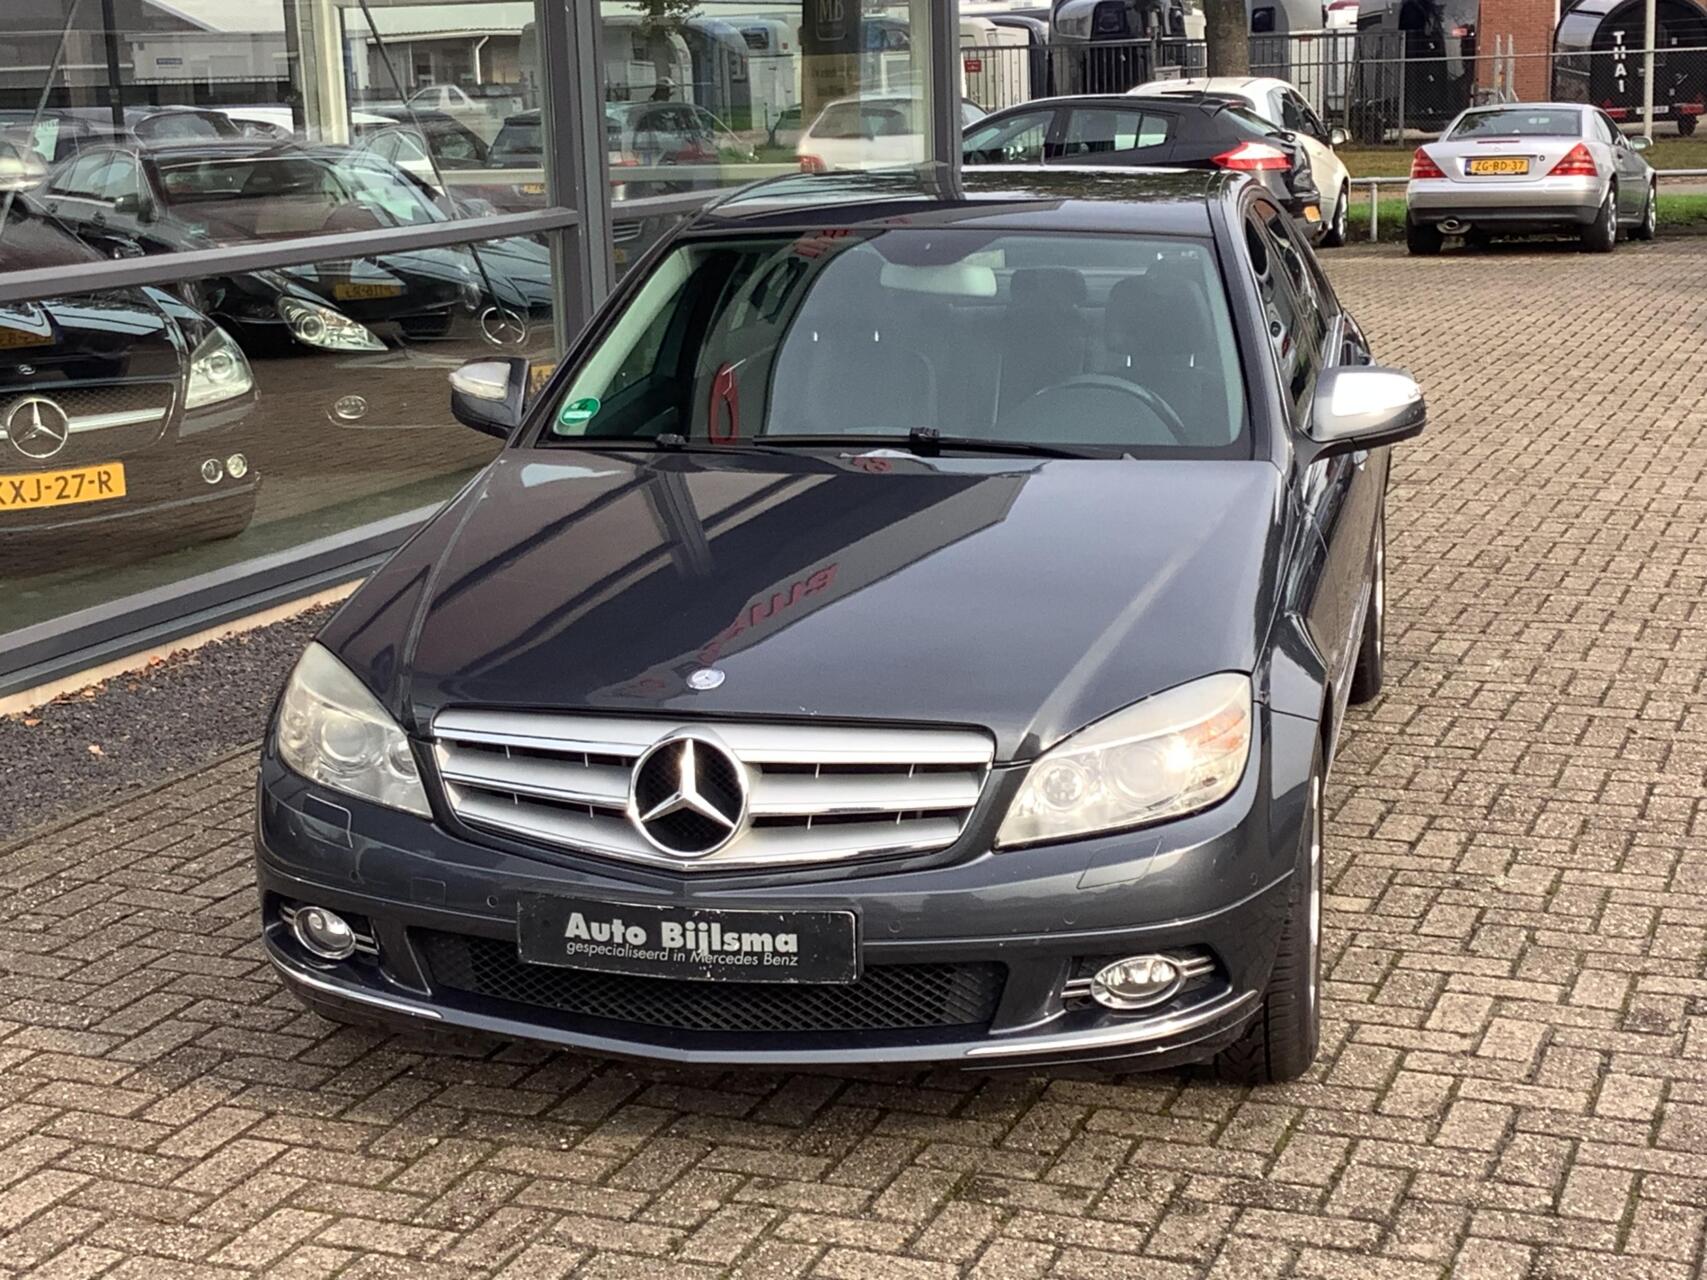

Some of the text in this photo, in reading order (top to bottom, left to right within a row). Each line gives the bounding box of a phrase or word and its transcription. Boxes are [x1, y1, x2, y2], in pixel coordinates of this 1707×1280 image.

[1613, 31, 1627, 93] THAI
[1475, 160, 1525, 172] ZG-BD-37
[564, 911, 799, 957] Auto Bijlsma
[566, 941, 799, 966] gespecialiseerd in Mercedes Benz
